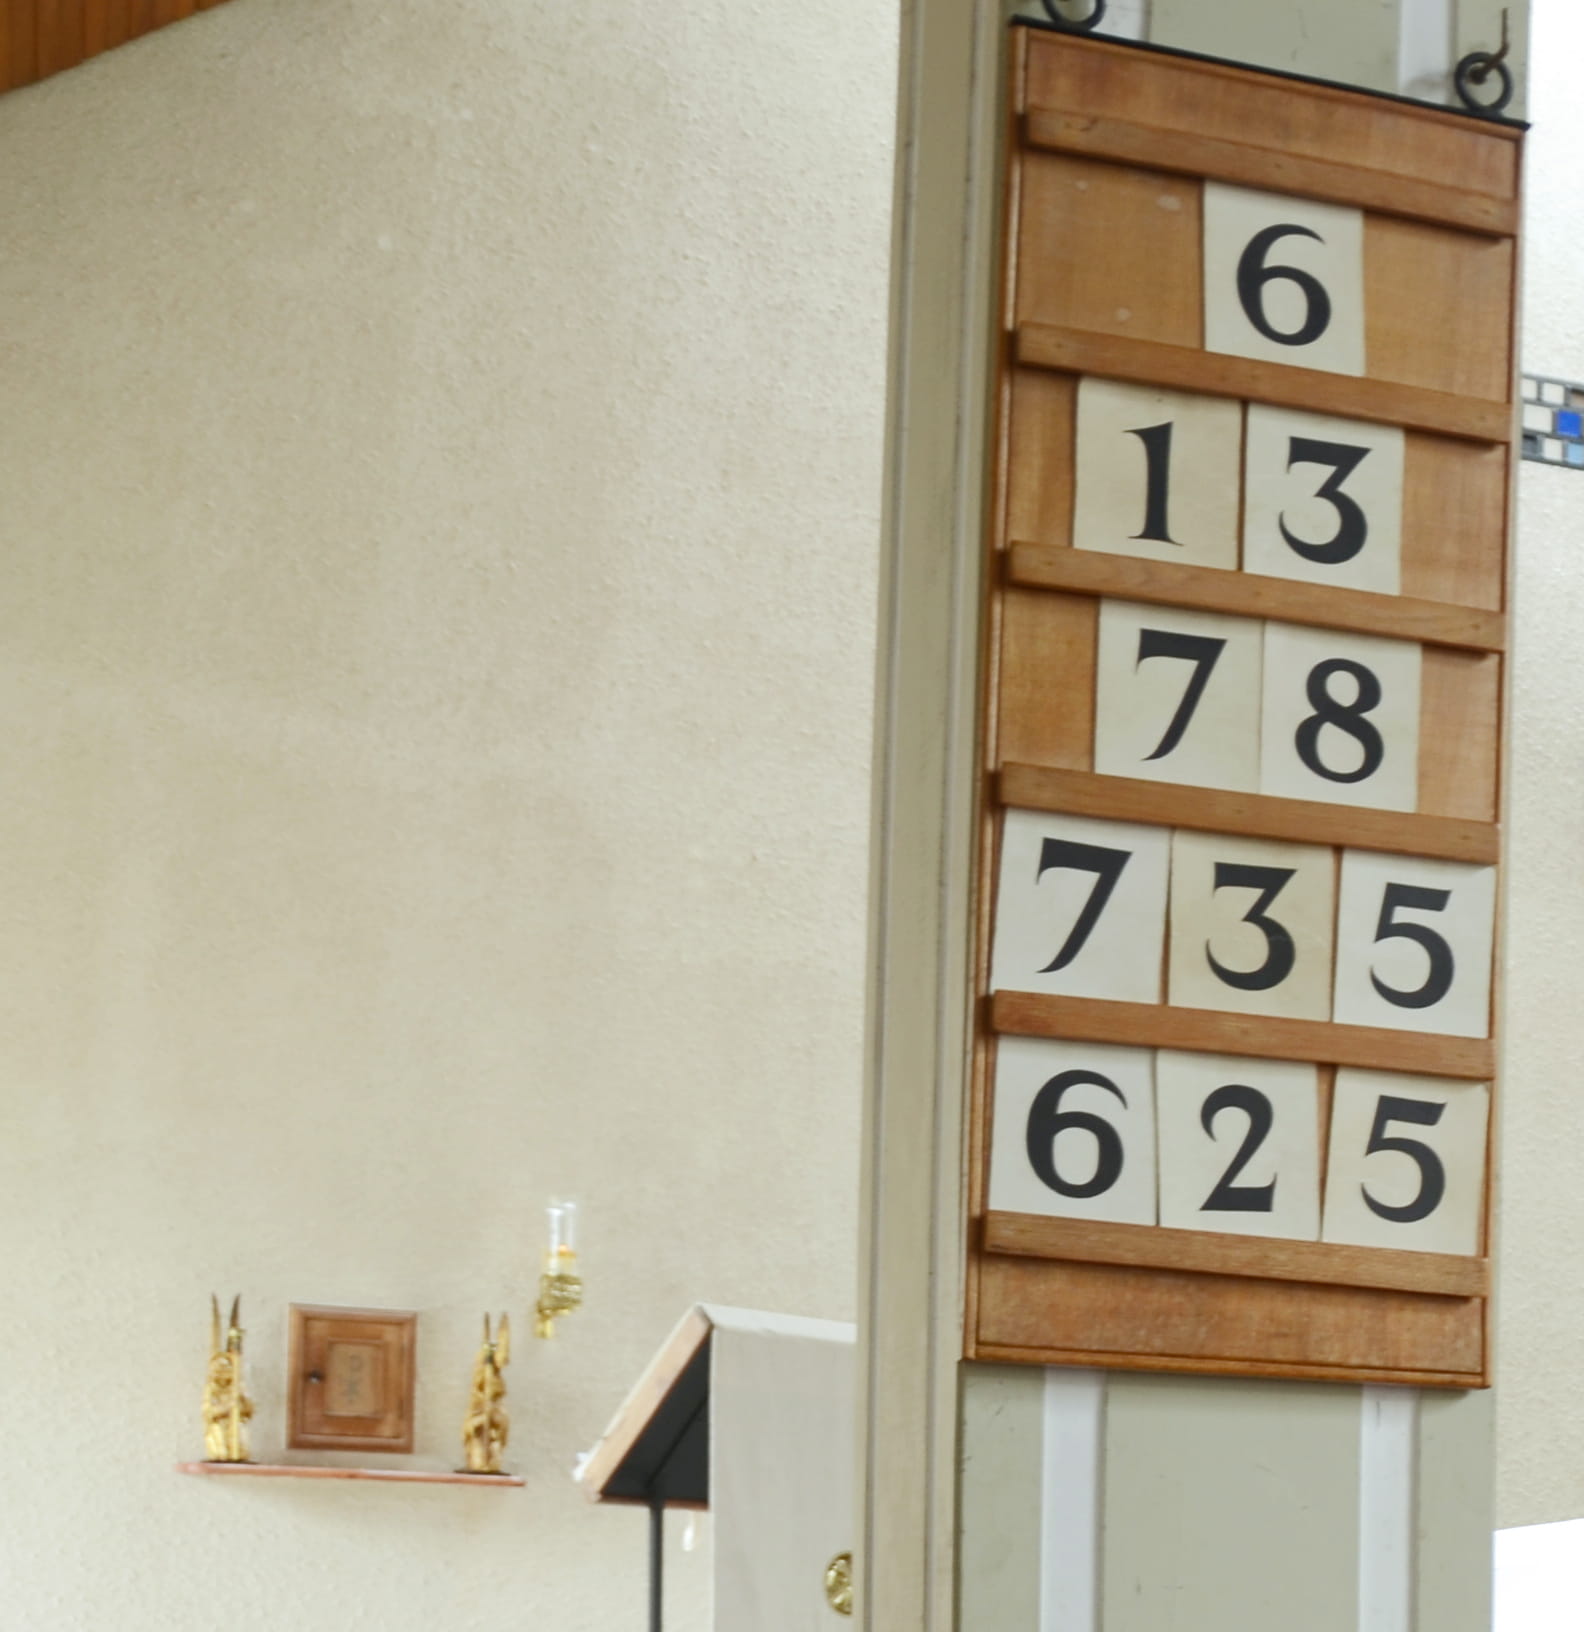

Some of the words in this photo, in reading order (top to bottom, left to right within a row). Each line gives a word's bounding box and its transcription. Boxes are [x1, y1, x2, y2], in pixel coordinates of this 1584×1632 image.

[1236, 223, 1331, 346] 6
[1124, 422, 1372, 565] 13
[1136, 628, 1384, 784] 78
[1036, 837, 1455, 1009] 735
[1026, 1069, 1447, 1223] 625
